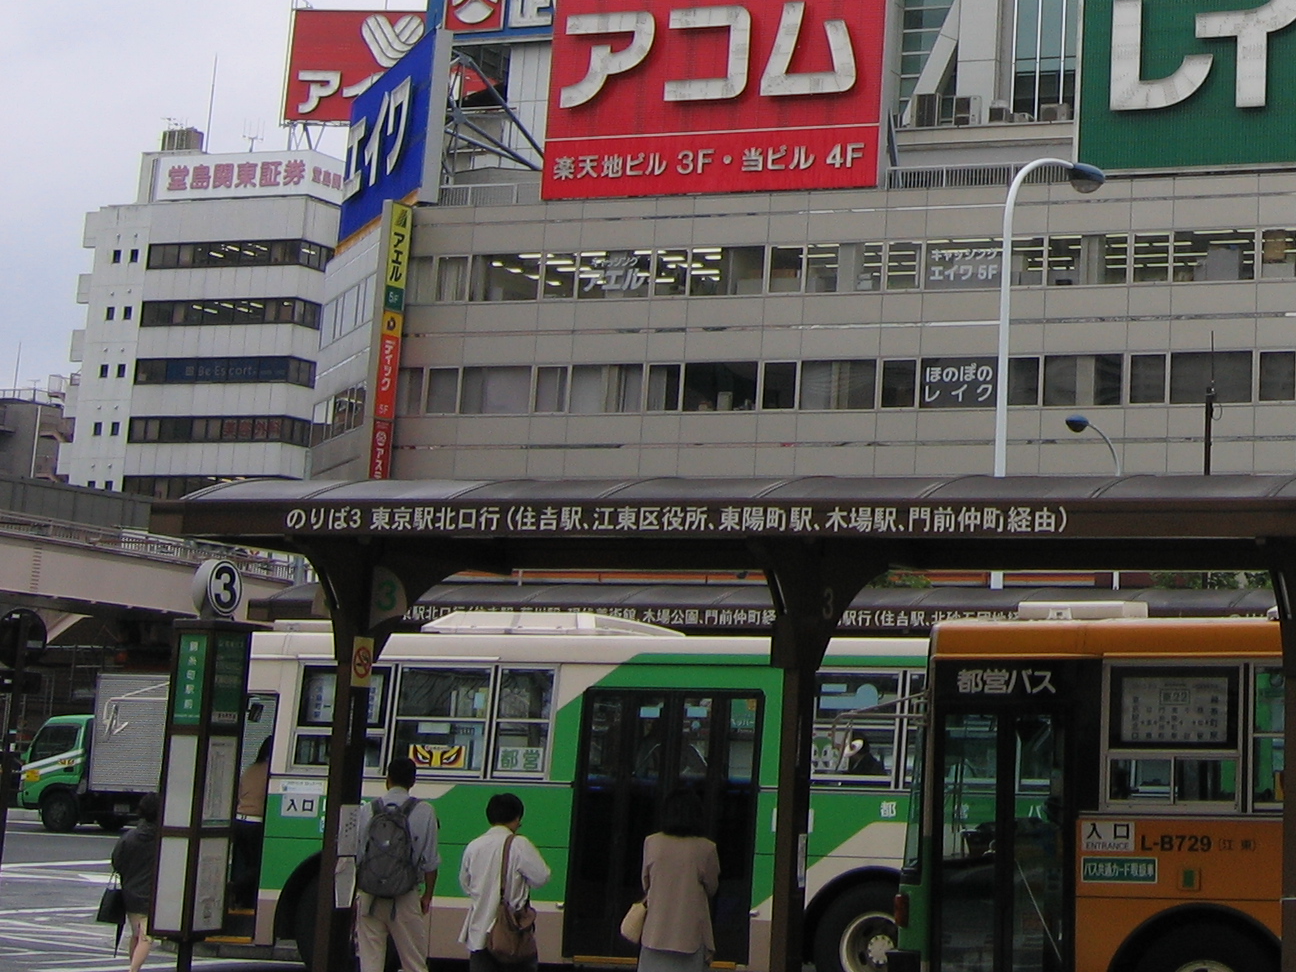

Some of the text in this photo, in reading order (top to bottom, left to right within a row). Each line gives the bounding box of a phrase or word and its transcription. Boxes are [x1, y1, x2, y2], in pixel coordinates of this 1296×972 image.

[559, 0, 857, 109] アコム
[553, 152, 667, 180] 楽天地ビル
[826, 142, 866, 168] 4F
[166, 159, 306, 192] 堂島関東証券
[388, 231, 406, 283] アエル
[931, 248, 997, 263] キャッシング
[581, 268, 646, 293] アエル
[929, 265, 973, 281] エイワ
[380, 340, 397, 391] ディック
[924, 383, 993, 403] レイク
[286, 506, 362, 530] のりば3
[214, 566, 237, 609] 3
[375, 579, 397, 611] 3
[821, 588, 834, 619] 3
[957, 669, 1057, 695] 都営バス
[501, 748, 541, 770] 都営
[286, 798, 315, 812] 入口
[1086, 823, 1131, 840] 入口
[1140, 835, 1212, 852] L-B729
[1085, 841, 1130, 851] ENTRANCE
